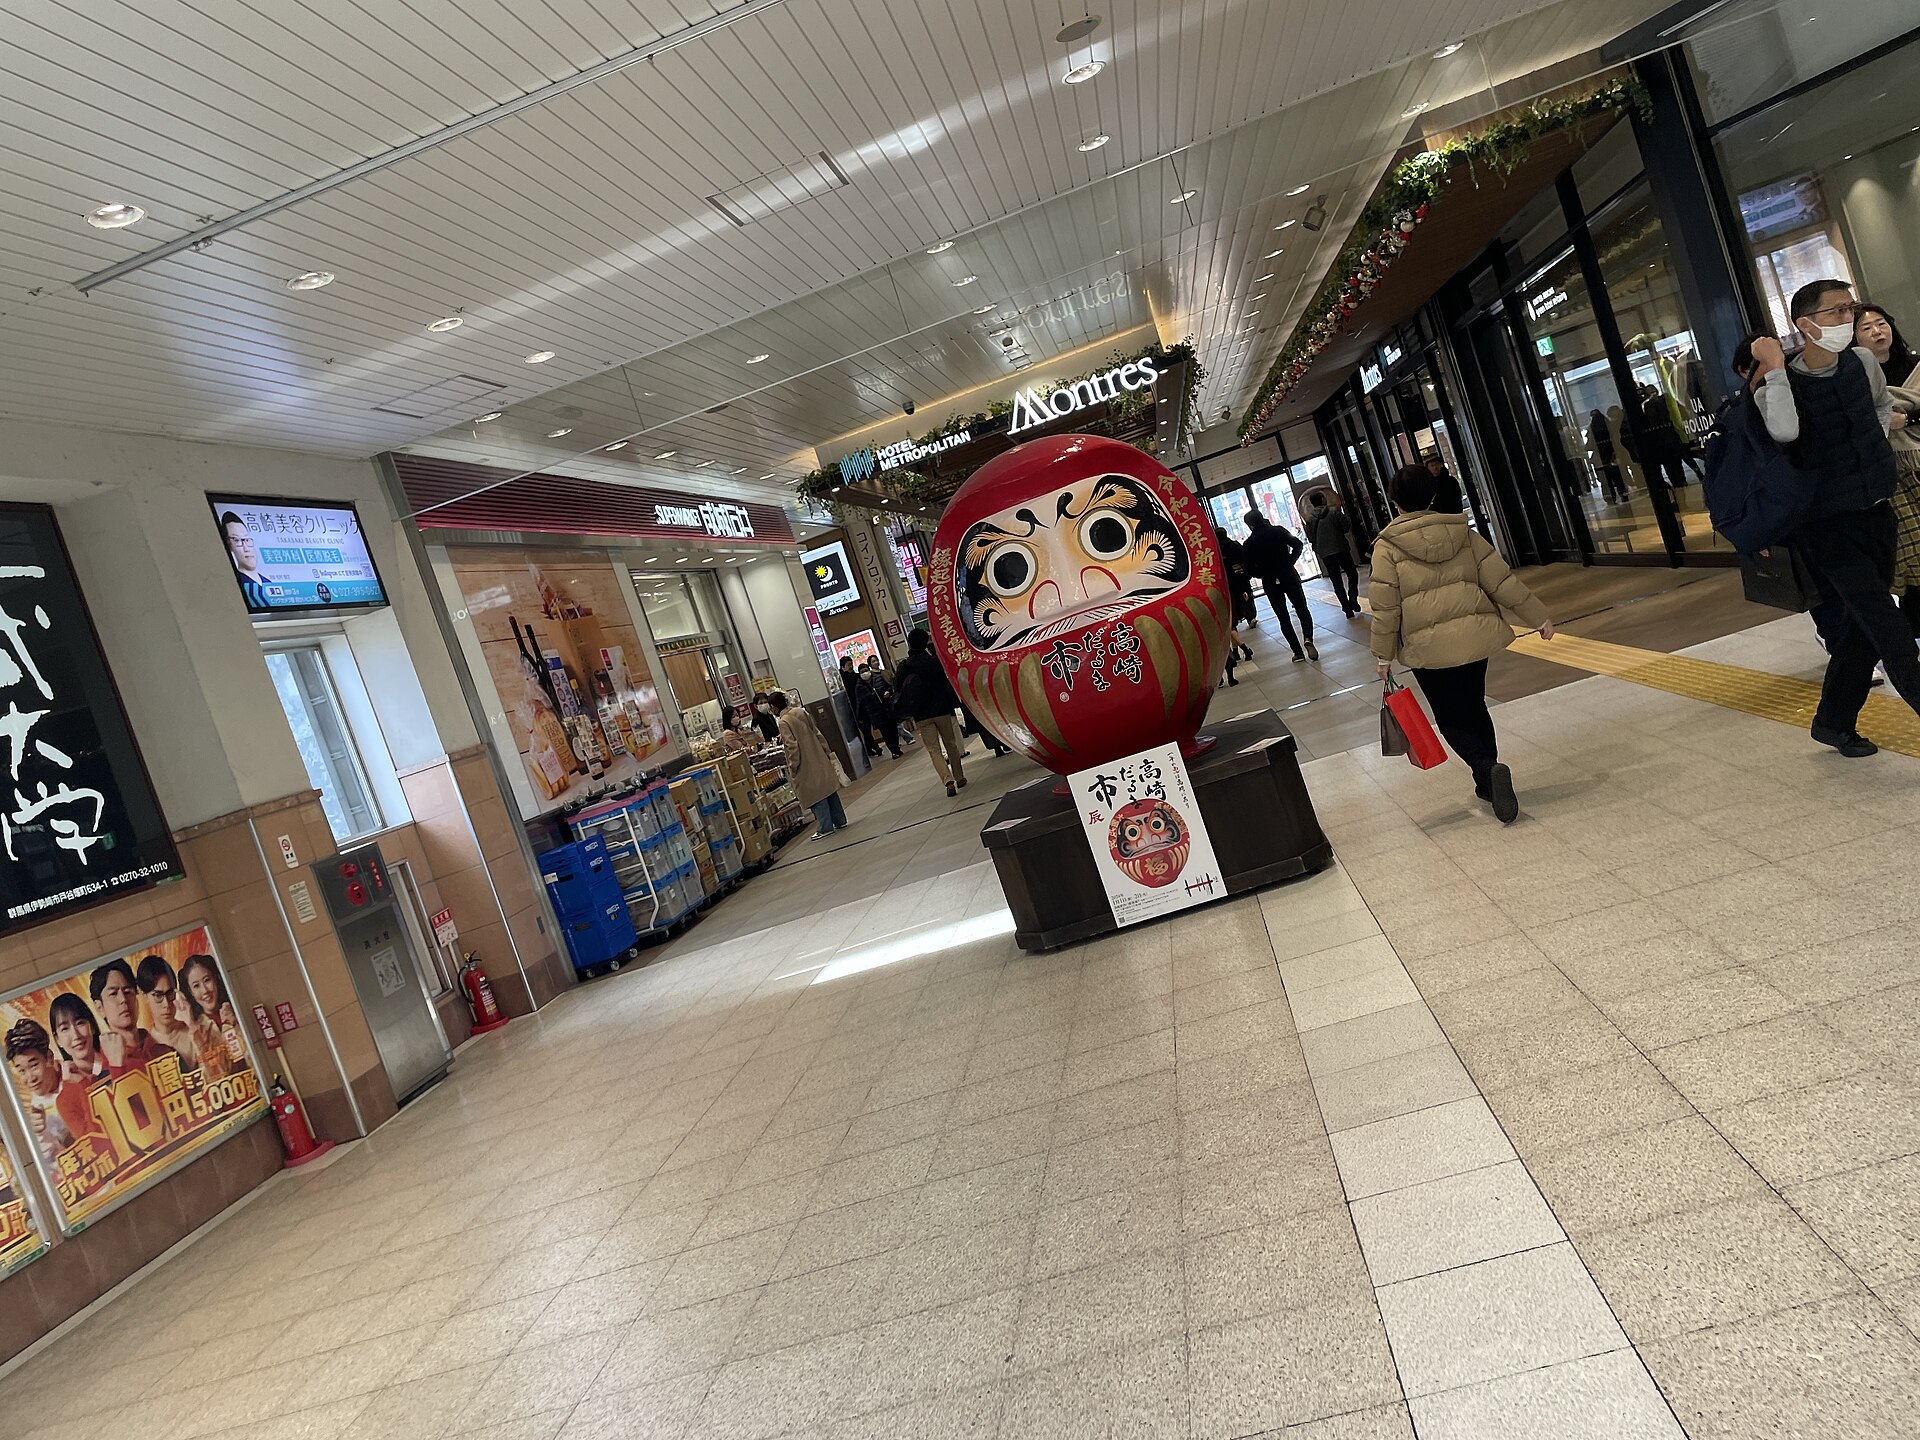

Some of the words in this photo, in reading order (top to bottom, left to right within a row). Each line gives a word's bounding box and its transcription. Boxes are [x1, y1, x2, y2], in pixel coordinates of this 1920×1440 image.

[1007, 357, 1160, 436] Montres
[1690, 397, 1705, 413] UA
[876, 438, 917, 461] HOTEL
[880, 431, 971, 472] METROPOLITAN
[243, 512, 359, 535] 高崎美容クリニック
[1157, 475, 1216, 586] 令和六年新春
[856, 532, 889, 611] コインロッカー
[1041, 640, 1083, 691] 市
[1082, 628, 1111, 691] だるま
[1108, 622, 1143, 684] 高崎
[1087, 774, 1118, 811] 市
[1119, 764, 1143, 809] だるま
[1138, 758, 1167, 801] 高崎
[1088, 809, 1105, 825] 辰
[118, 861, 168, 884] 0270-32-1010
[59, 1137, 97, 1174] 年末
[57, 1150, 117, 1206] ジャンボ
